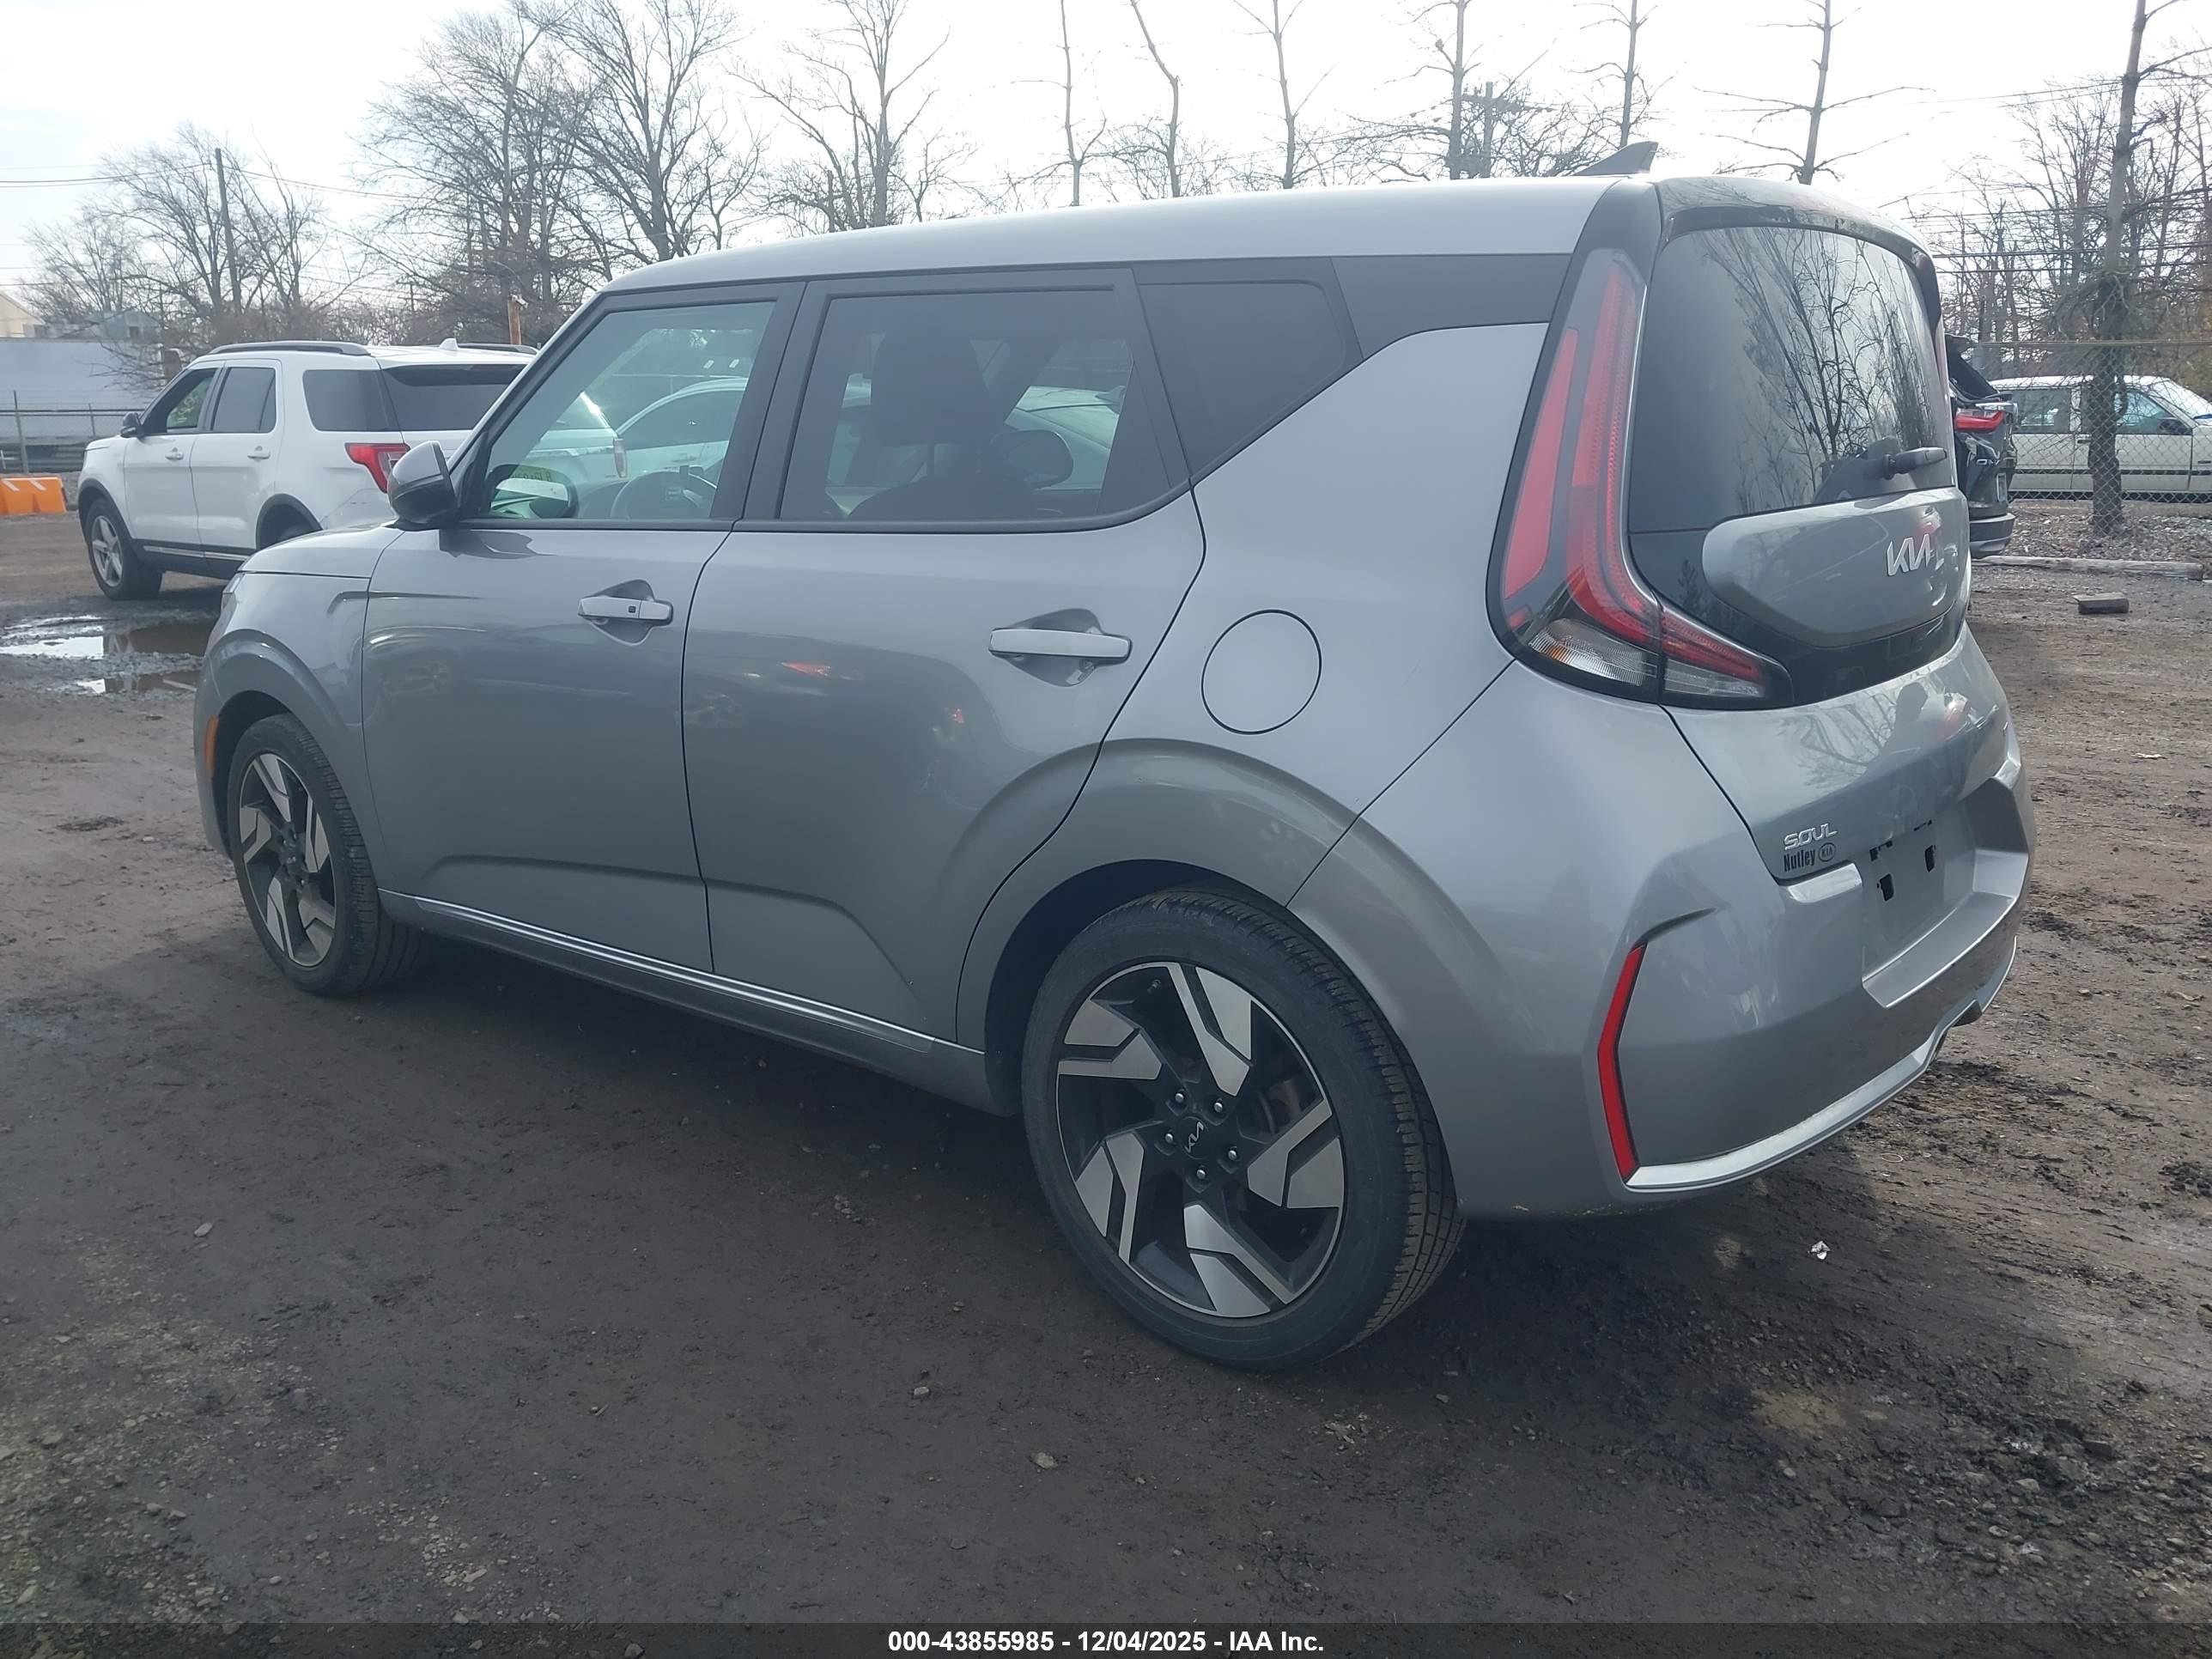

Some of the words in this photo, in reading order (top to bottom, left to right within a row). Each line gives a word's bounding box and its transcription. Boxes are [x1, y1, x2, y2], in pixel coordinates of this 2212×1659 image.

[1887, 533, 1931, 576] KIA
[1784, 823, 1838, 850] SOUL
[1784, 848, 1816, 872] Nutley
